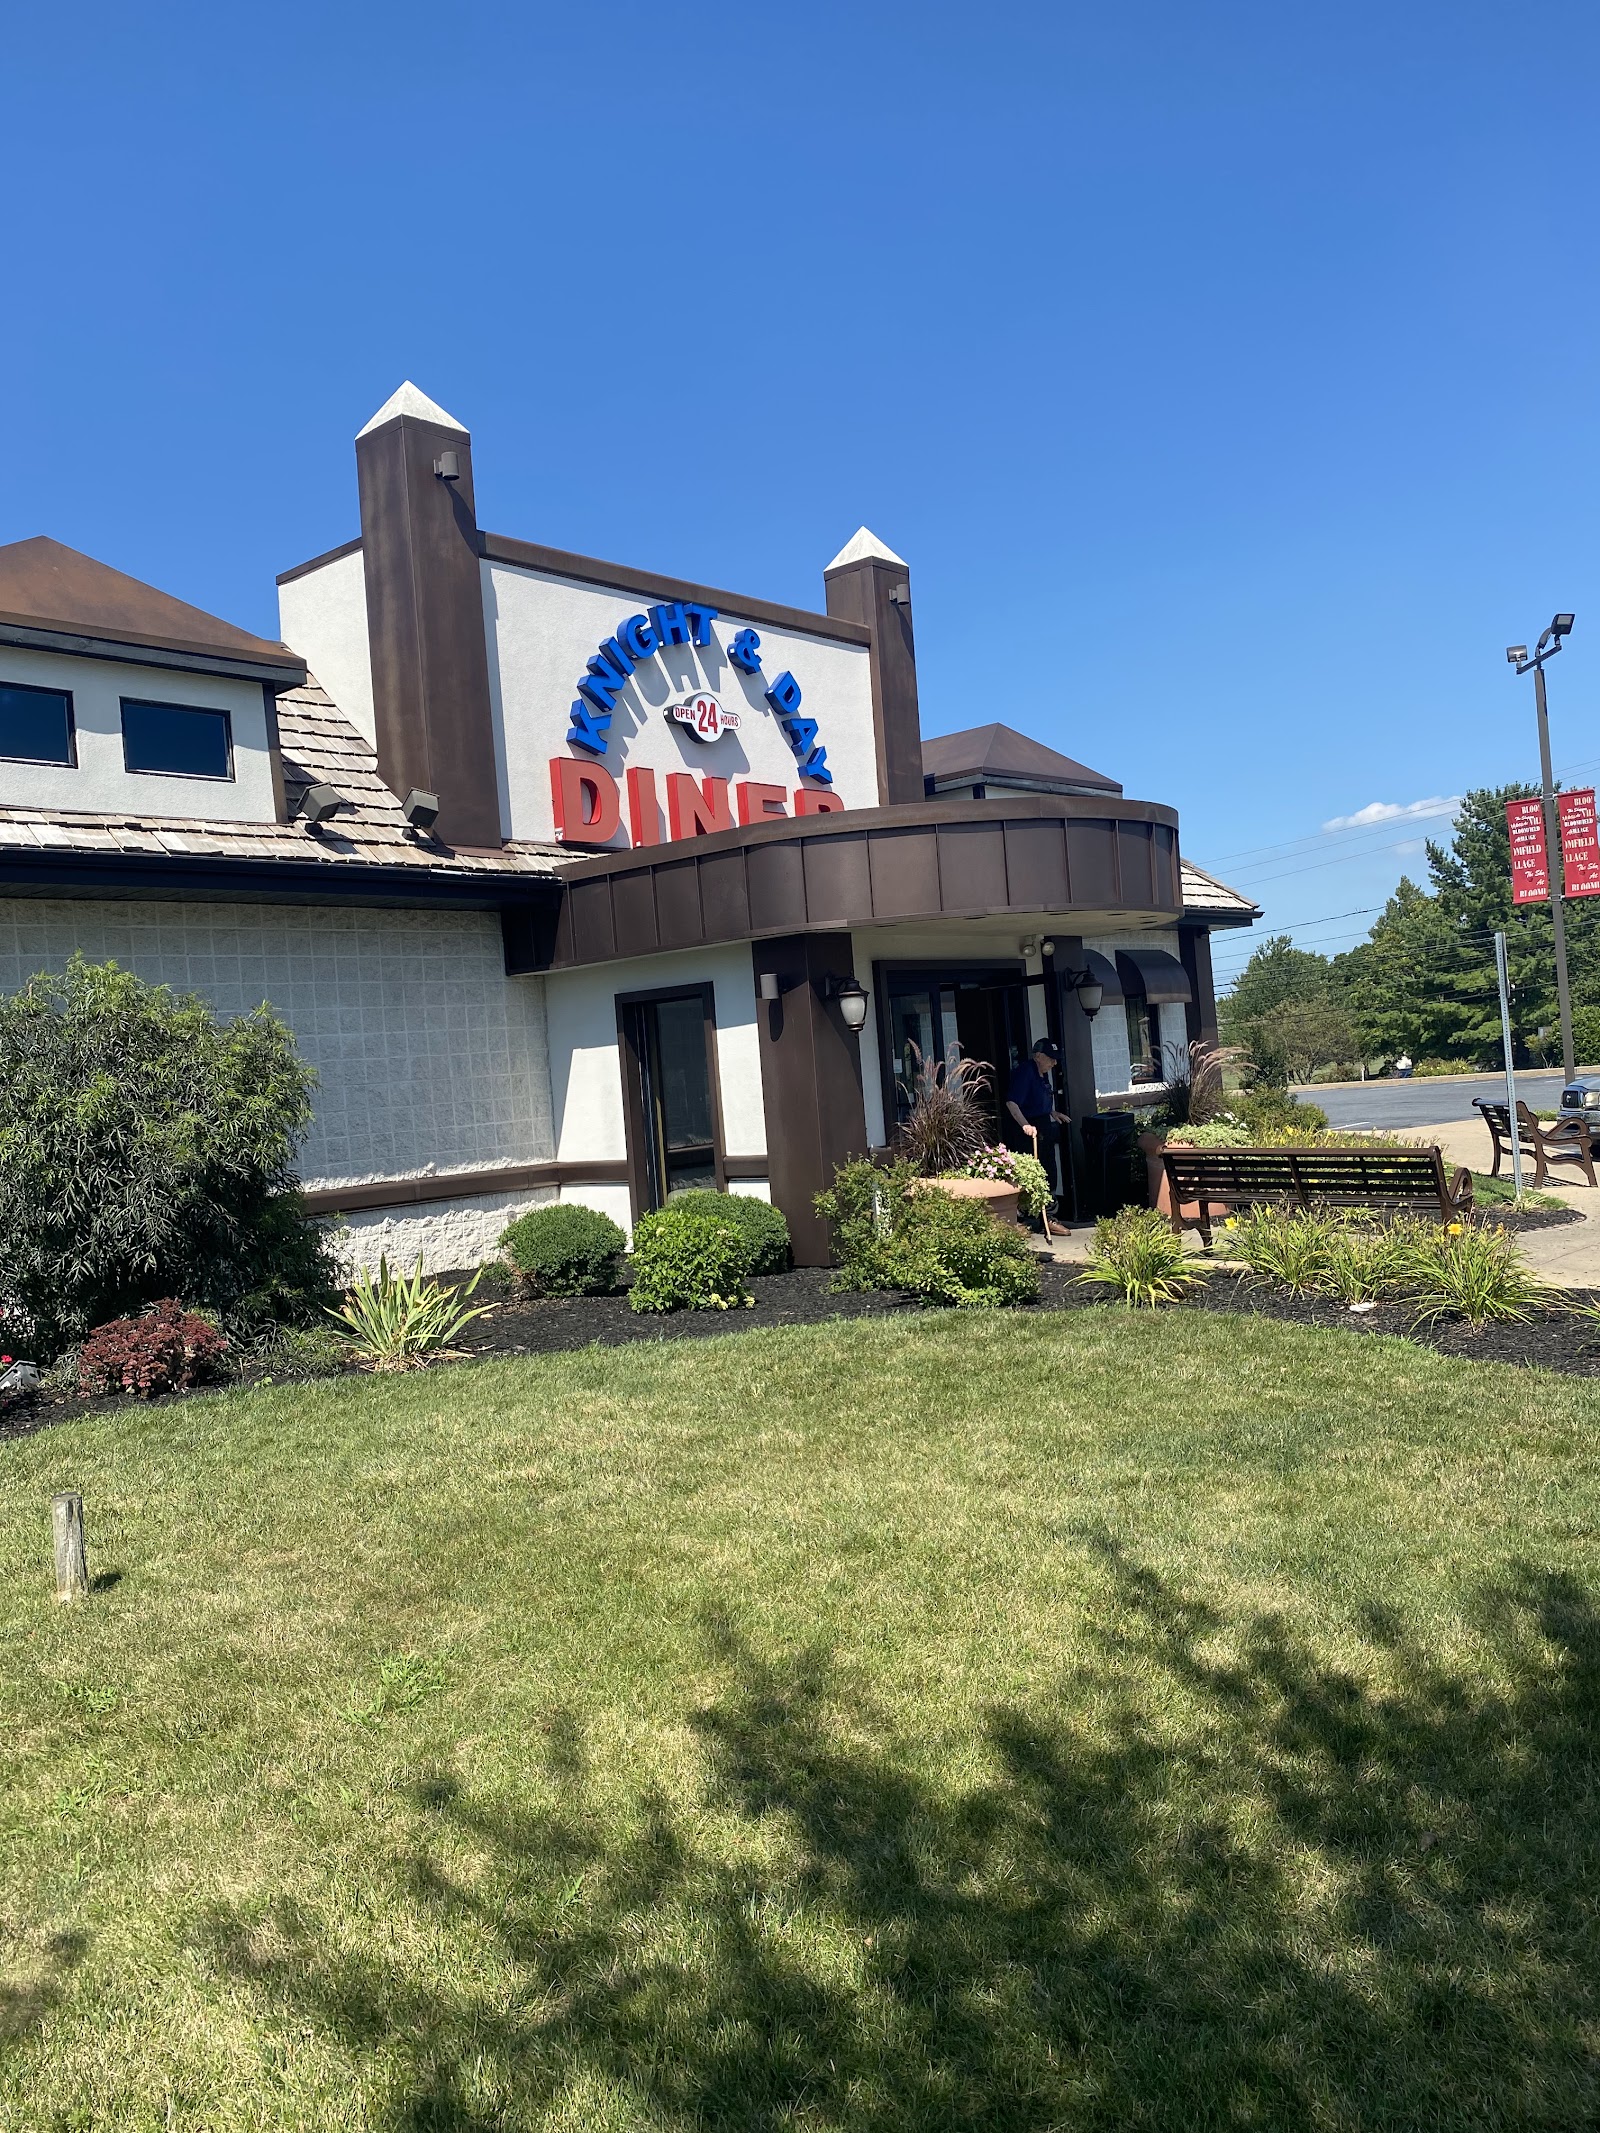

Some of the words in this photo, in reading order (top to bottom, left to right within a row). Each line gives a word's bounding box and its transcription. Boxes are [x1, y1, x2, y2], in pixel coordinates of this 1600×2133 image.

[566, 602, 718, 755] KNIGHT
[727, 628, 762, 675] &
[765, 671, 833, 785] DAY
[675, 707, 696, 721] OPEN
[697, 700, 719, 734] 24
[720, 714, 740, 728] HOURS
[1522, 804, 1540, 815] BLOO
[1574, 796, 1593, 806] BLOO
